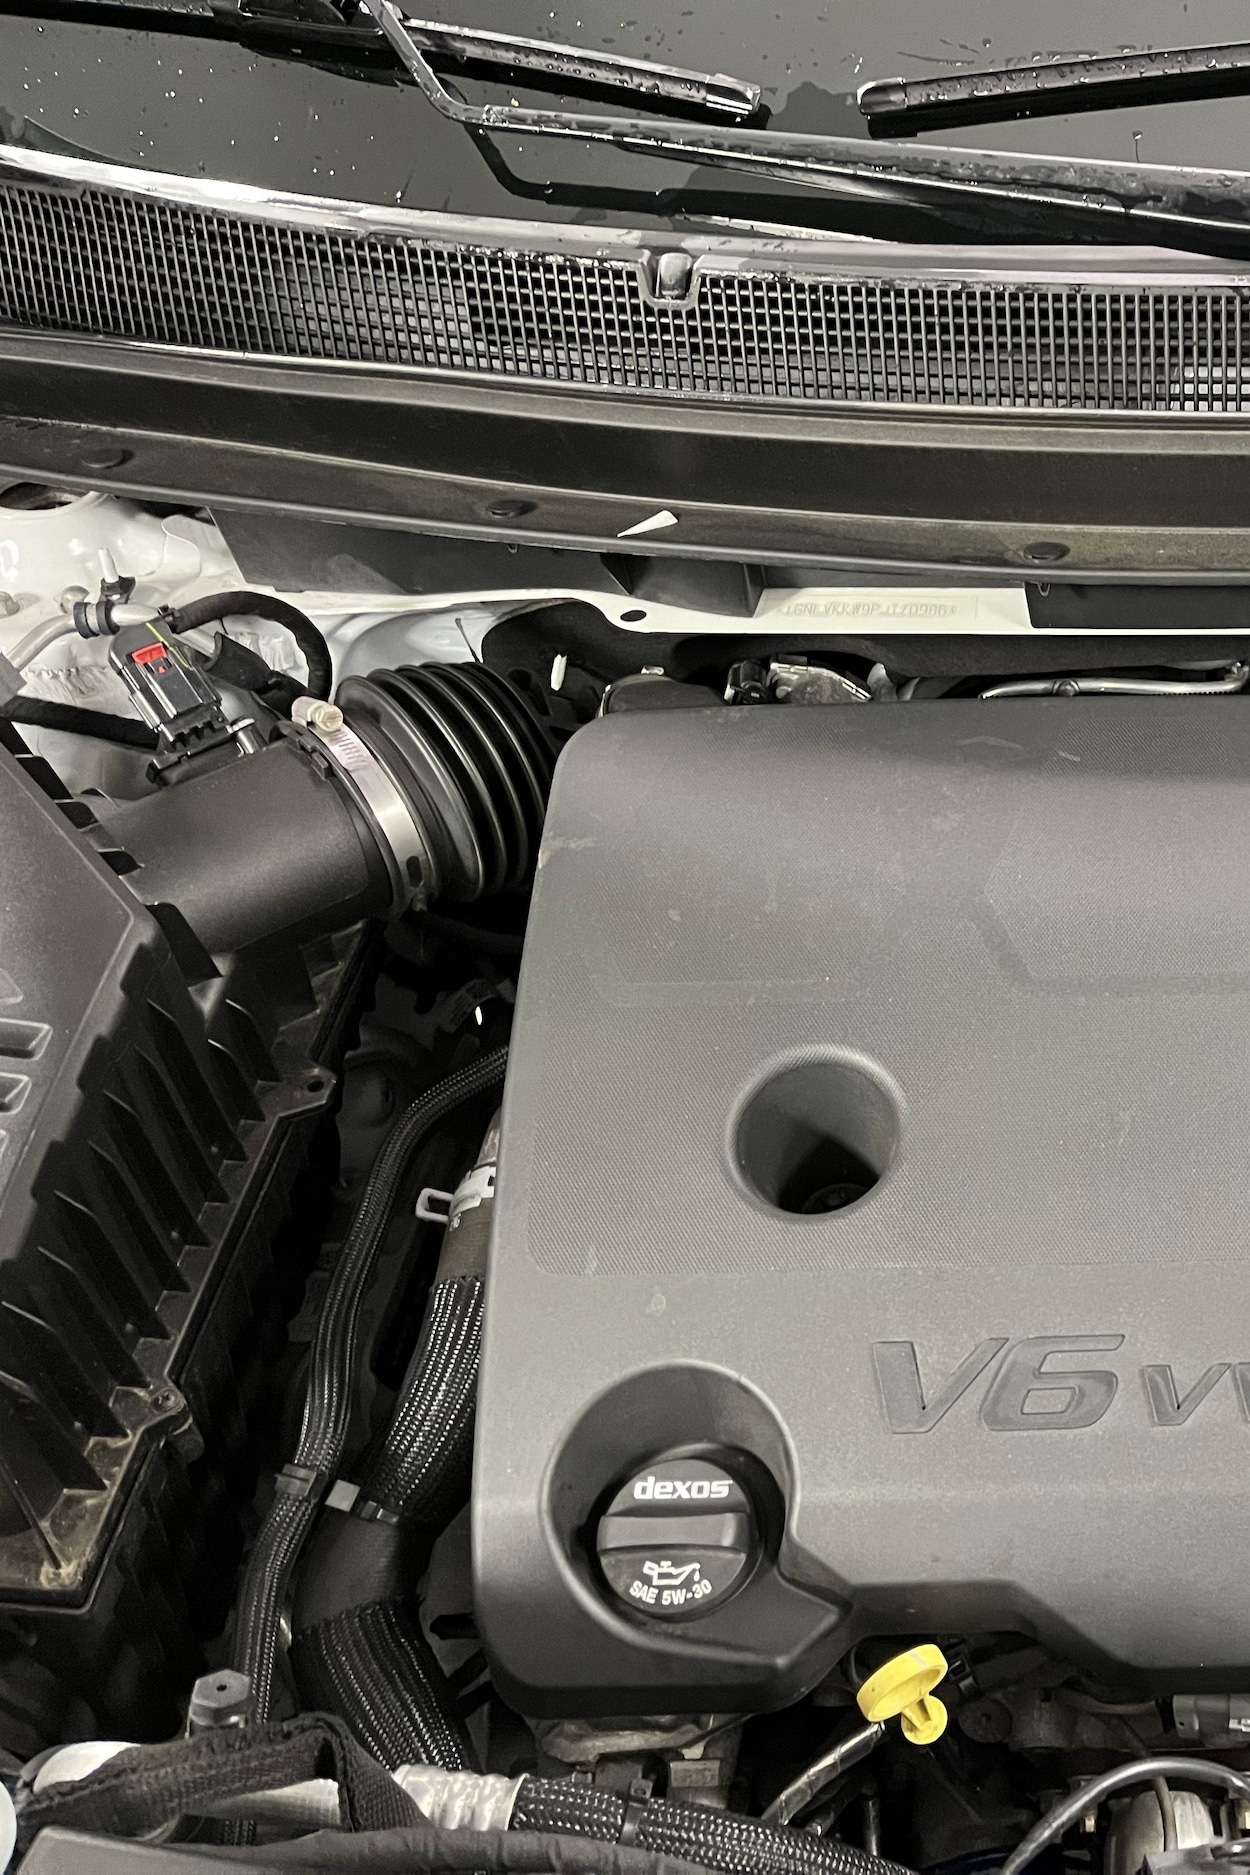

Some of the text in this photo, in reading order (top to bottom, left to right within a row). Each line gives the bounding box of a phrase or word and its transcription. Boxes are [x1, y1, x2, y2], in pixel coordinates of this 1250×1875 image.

[872, 1334, 1126, 1434] V6
[633, 1475, 733, 1500] dexos
[629, 1579, 712, 1605] SAE 5W-30
